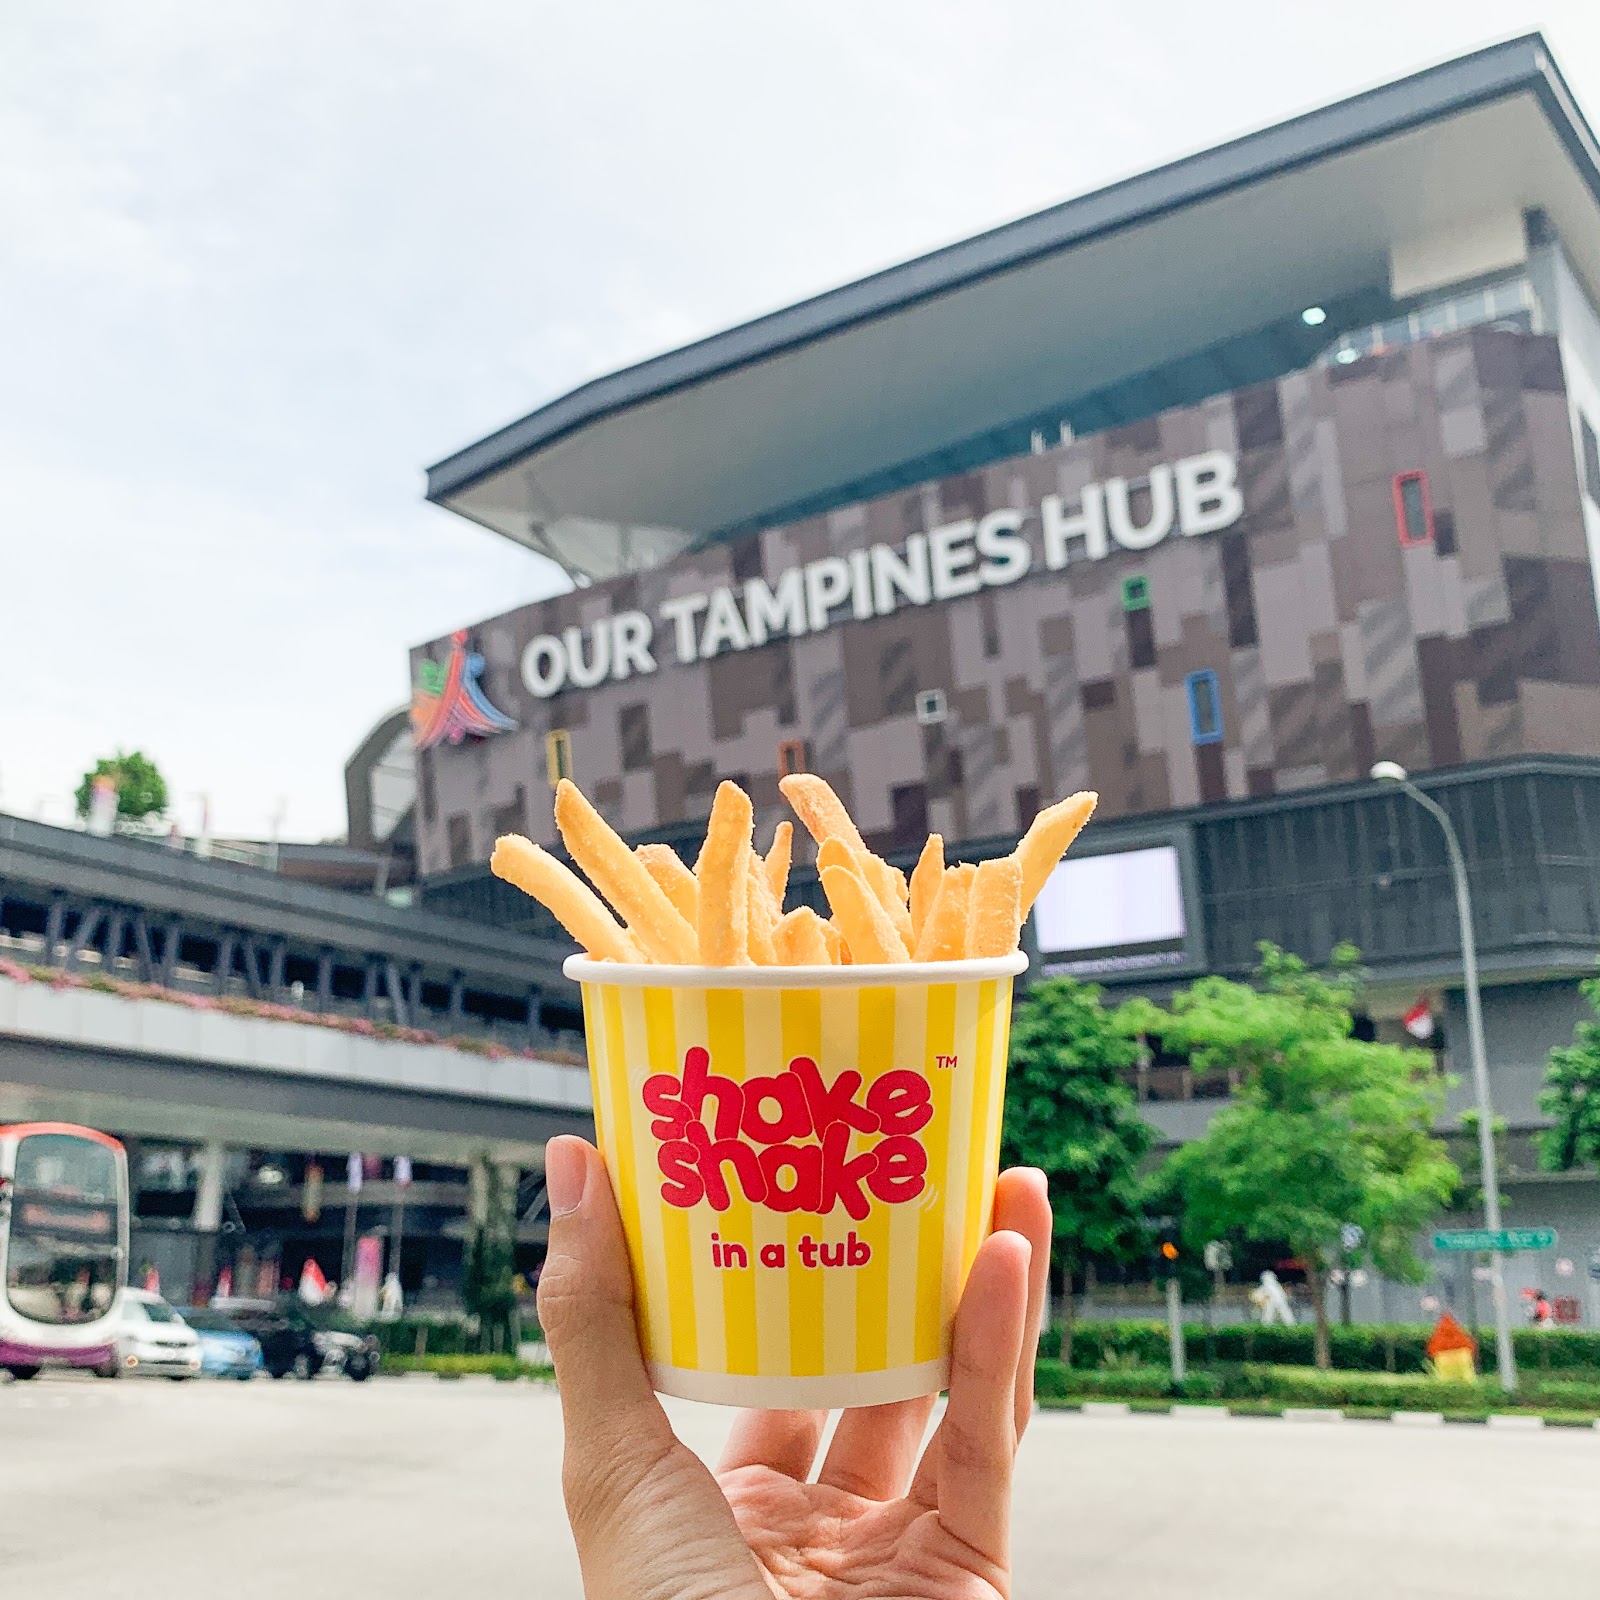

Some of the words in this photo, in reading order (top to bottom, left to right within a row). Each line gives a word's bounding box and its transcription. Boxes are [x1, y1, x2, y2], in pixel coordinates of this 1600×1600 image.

[521, 611, 656, 699] OUR
[660, 508, 1033, 664] TAMPINES
[1040, 450, 1244, 571] HUB
[642, 1046, 933, 1145] shake
[935, 1055, 958, 1069] TM
[657, 1121, 928, 1221] shake
[711, 1233, 747, 1268] in
[760, 1244, 785, 1268] a
[798, 1231, 871, 1268] tub
